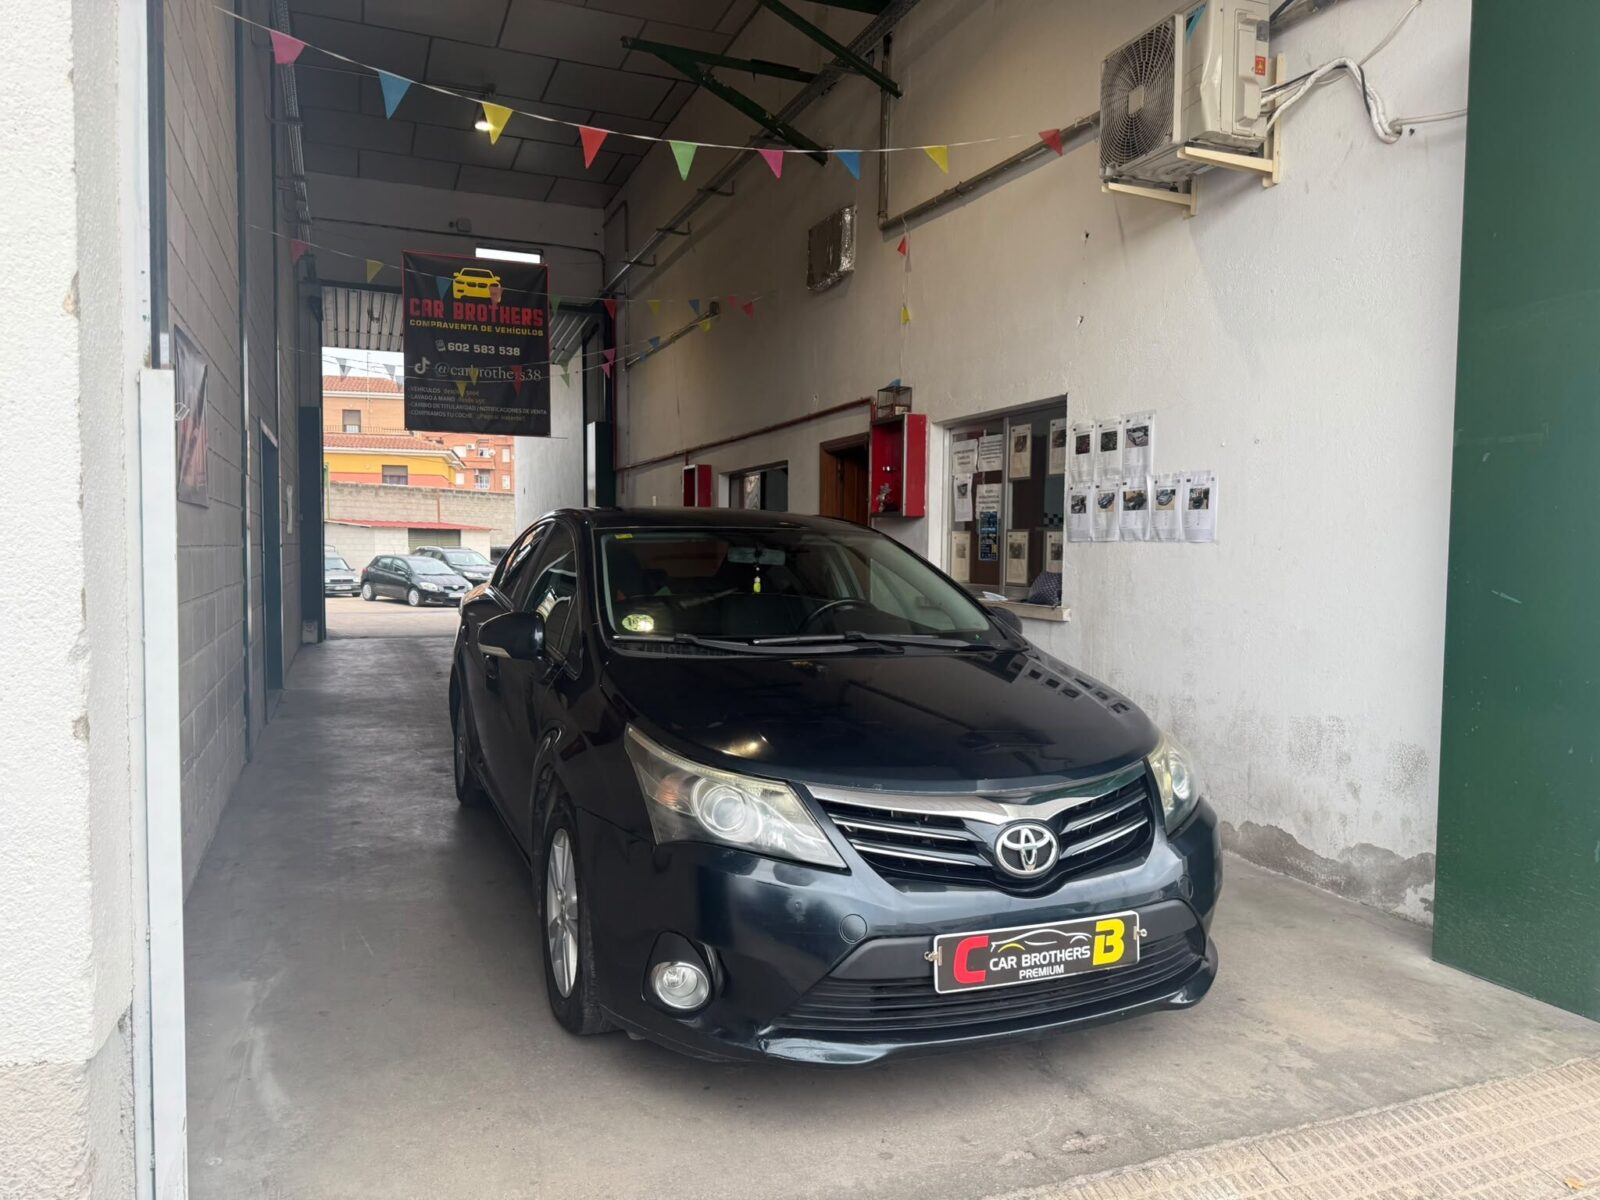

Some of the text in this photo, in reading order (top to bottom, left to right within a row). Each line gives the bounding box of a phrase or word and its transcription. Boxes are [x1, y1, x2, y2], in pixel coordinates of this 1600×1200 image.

[409, 298, 544, 326] CAR BROTHERS
[409, 319, 478, 331] COMPRAVENTA
[447, 342, 520, 356] 602 583 538
[990, 945, 1090, 971] CAR BROTHERS
[1019, 965, 1064, 979] PREMIUM
